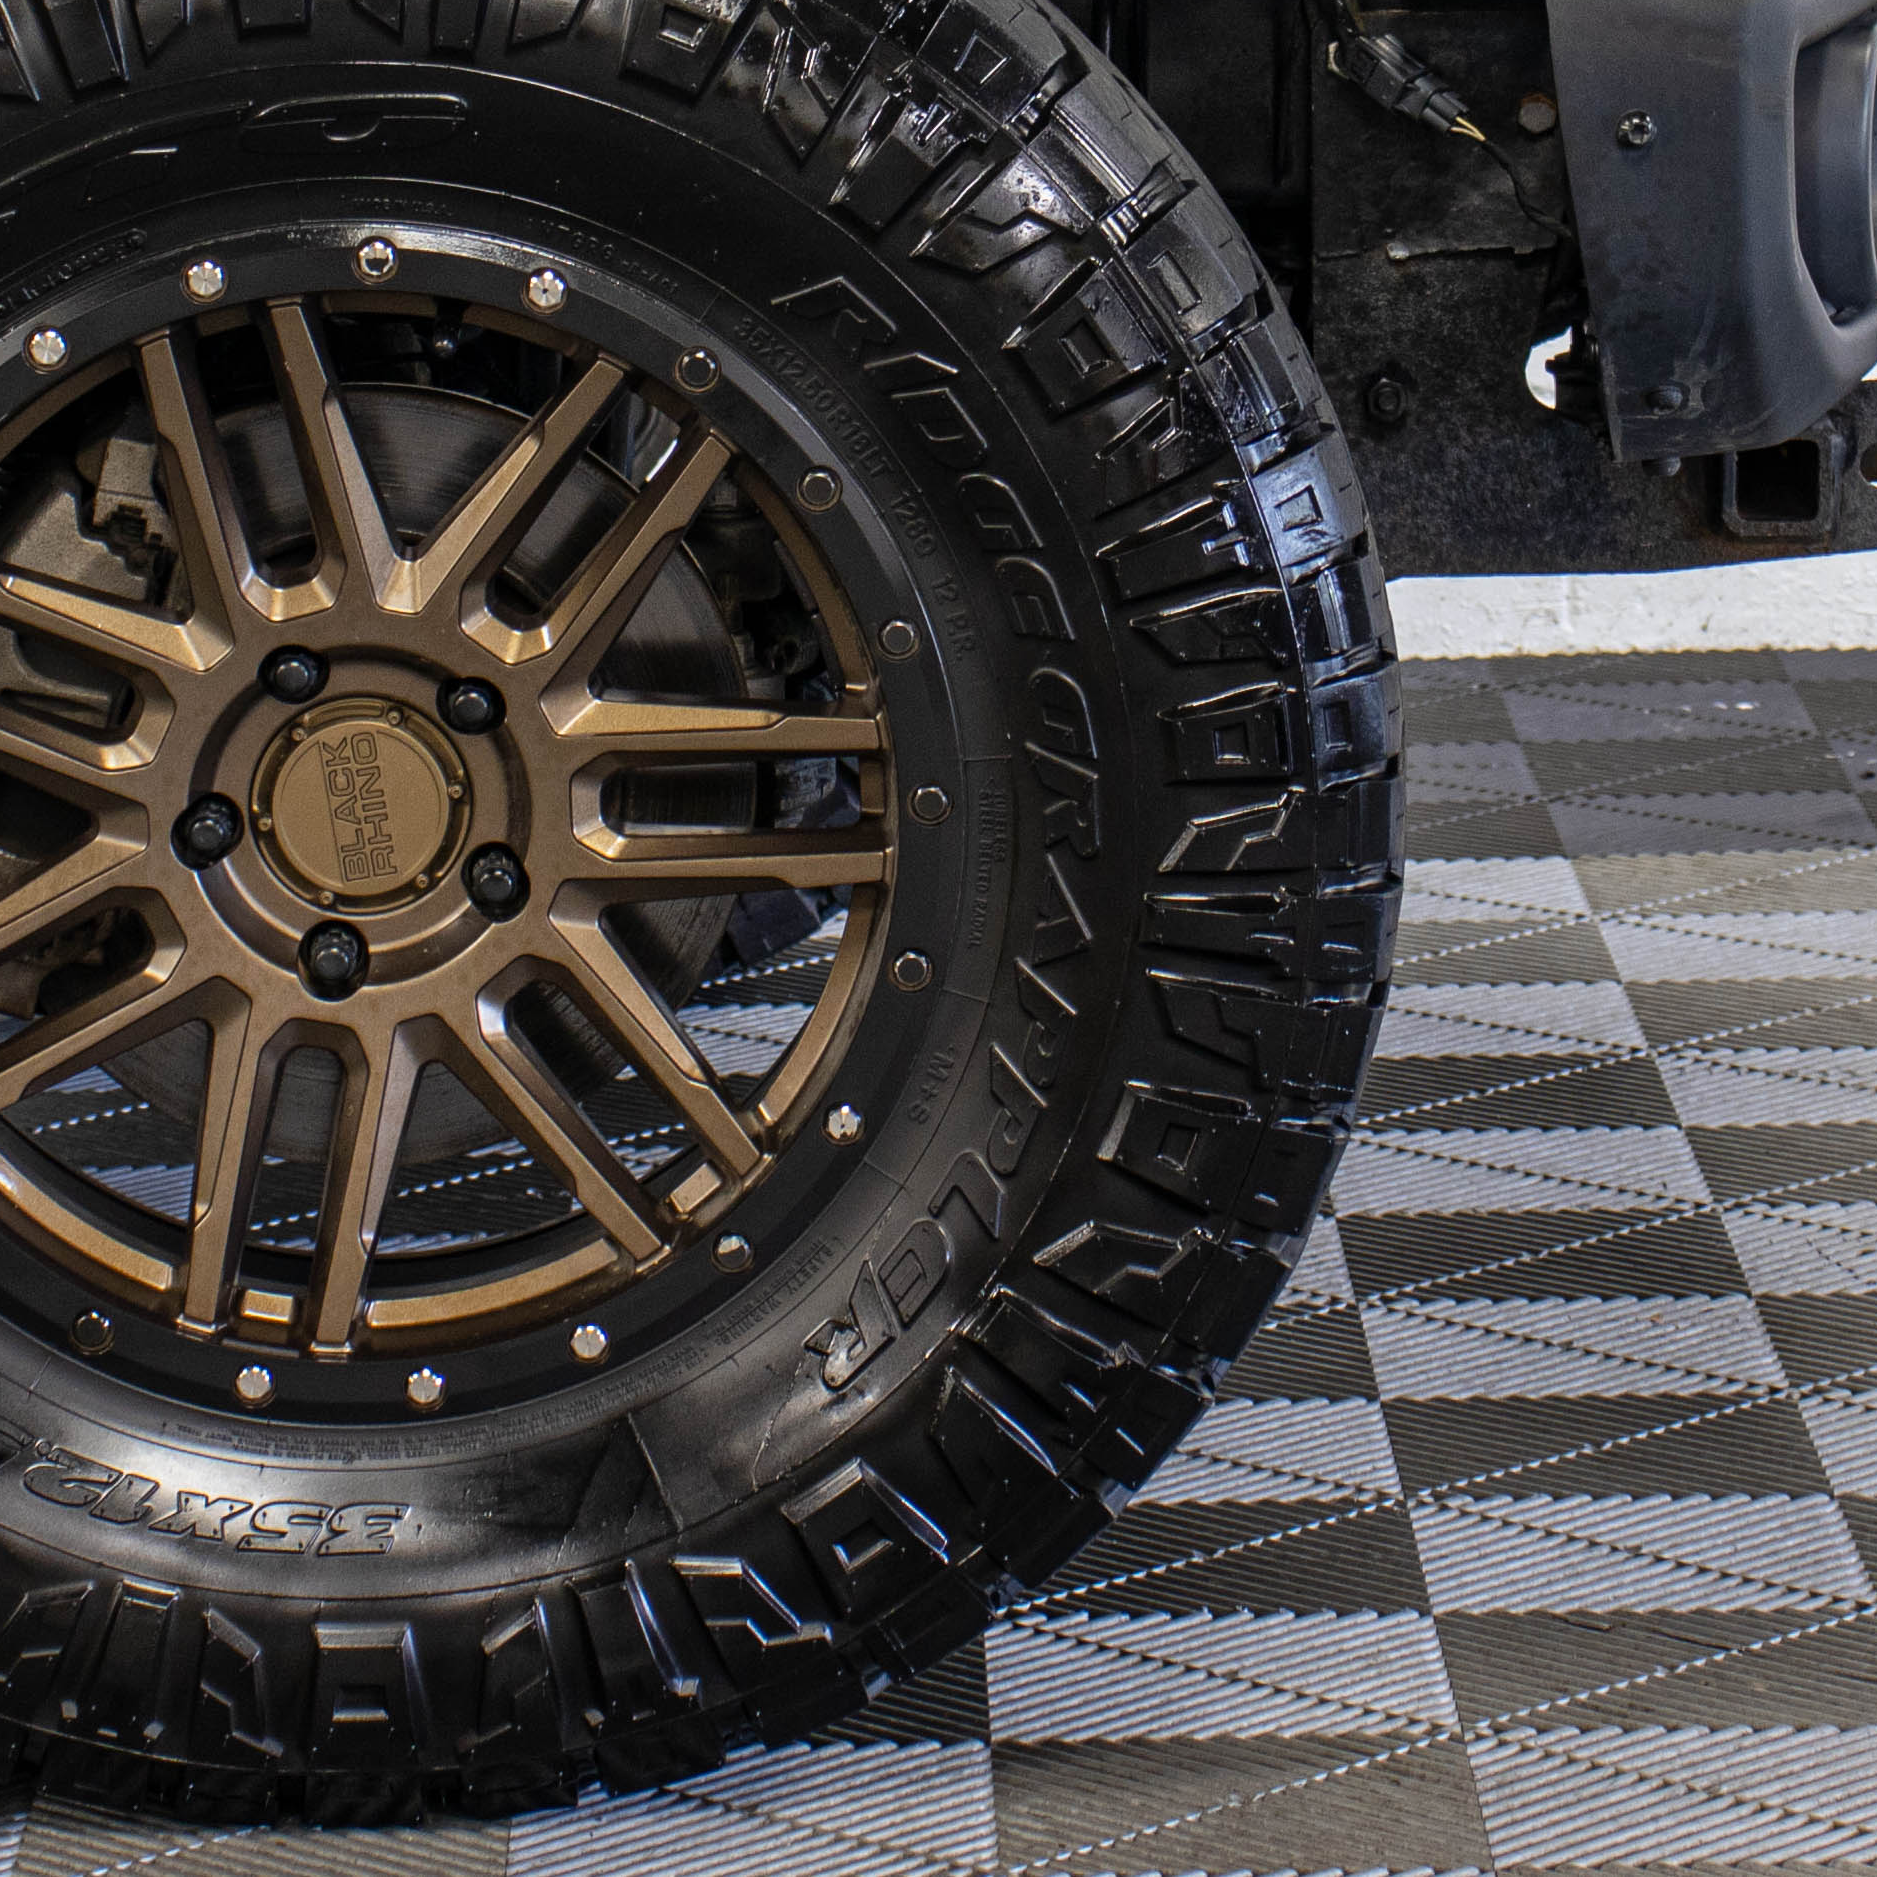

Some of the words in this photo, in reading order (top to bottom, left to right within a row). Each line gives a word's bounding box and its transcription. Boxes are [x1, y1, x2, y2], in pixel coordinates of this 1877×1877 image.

[322, 736, 371, 883] BLACK
[350, 731, 398, 878] RHINO
[968, 898, 988, 947] RADIAL
[803, 665, 1101, 1392] GRAPPLER
